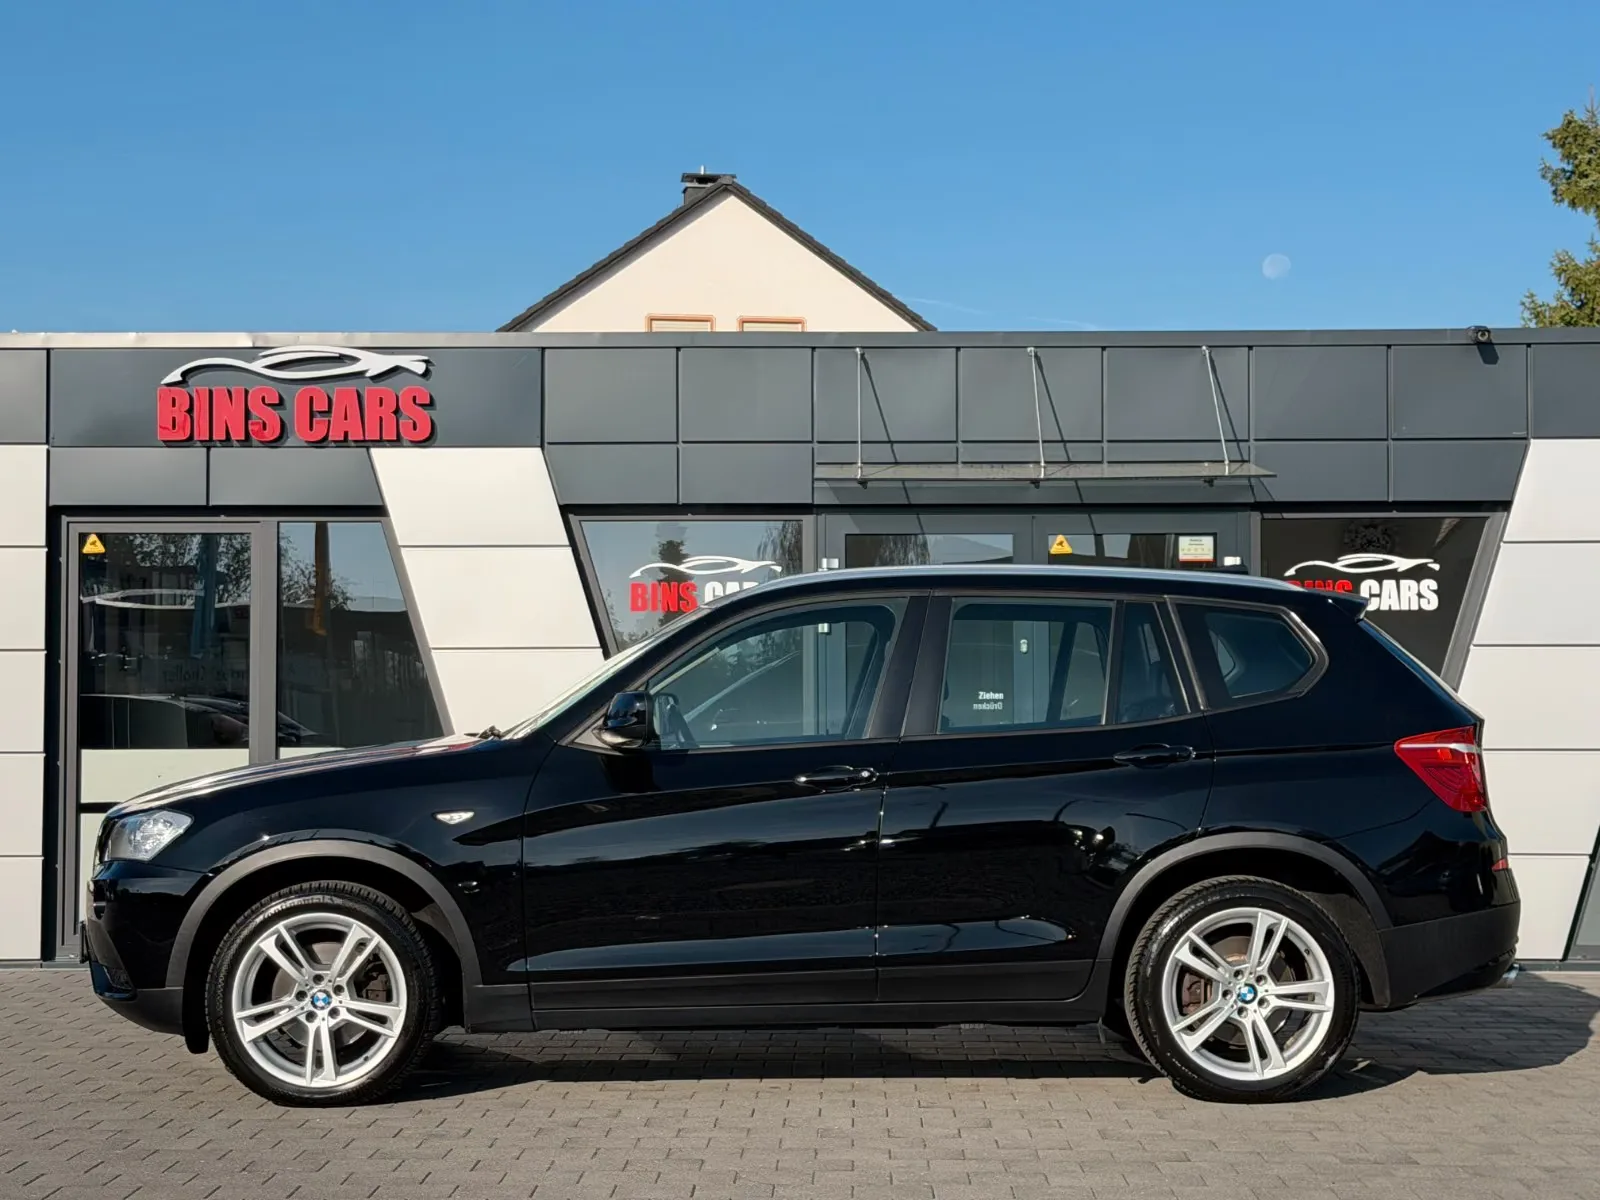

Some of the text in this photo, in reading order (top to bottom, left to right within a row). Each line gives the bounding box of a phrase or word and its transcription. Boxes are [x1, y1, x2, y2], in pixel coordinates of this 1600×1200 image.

[157, 385, 432, 442] BINS CARS
[630, 581, 698, 613] BINS
[1360, 578, 1439, 611] CARS
[978, 691, 1004, 700] Ziehen
